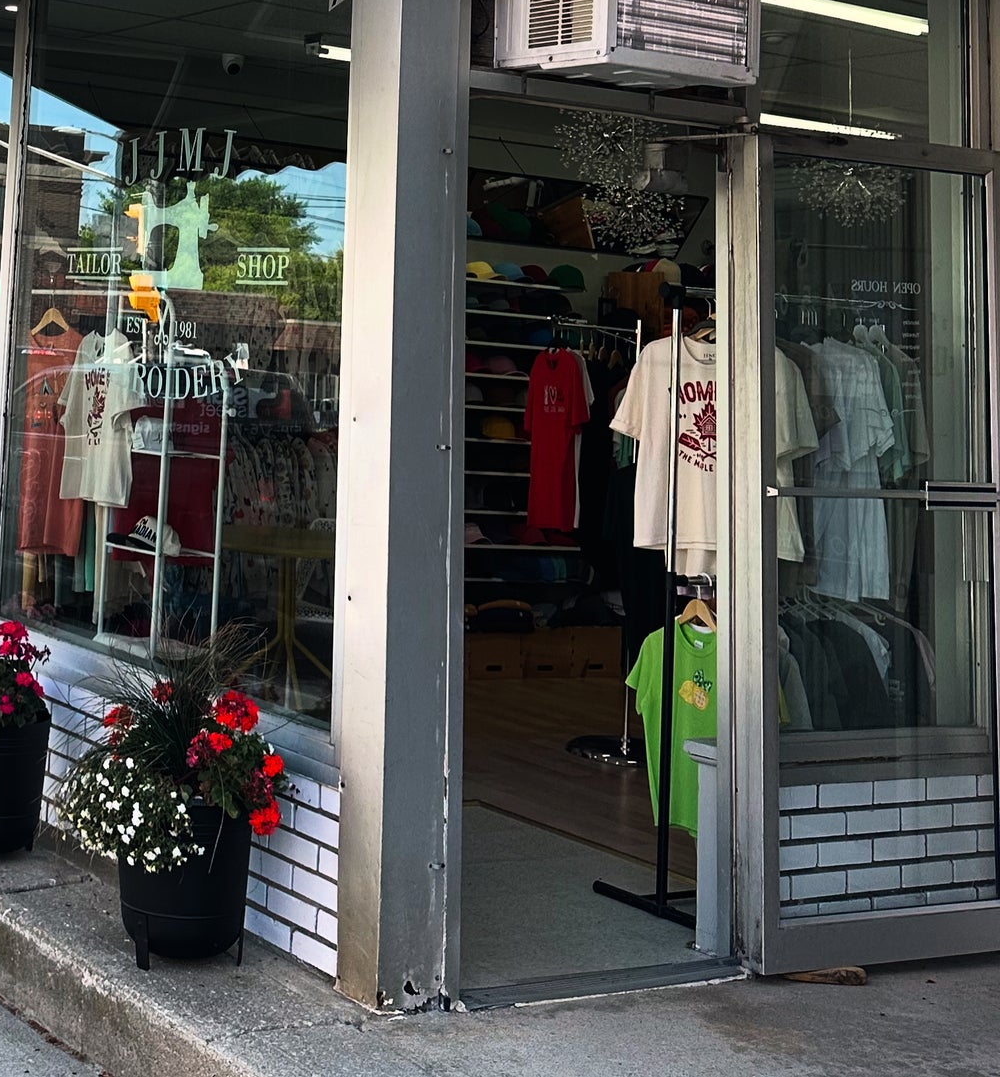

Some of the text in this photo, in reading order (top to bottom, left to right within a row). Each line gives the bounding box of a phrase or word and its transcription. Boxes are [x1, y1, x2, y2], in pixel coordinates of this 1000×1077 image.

[66, 252, 290, 279] TAILOR SHOP
[174, 320, 197, 339] 1981
